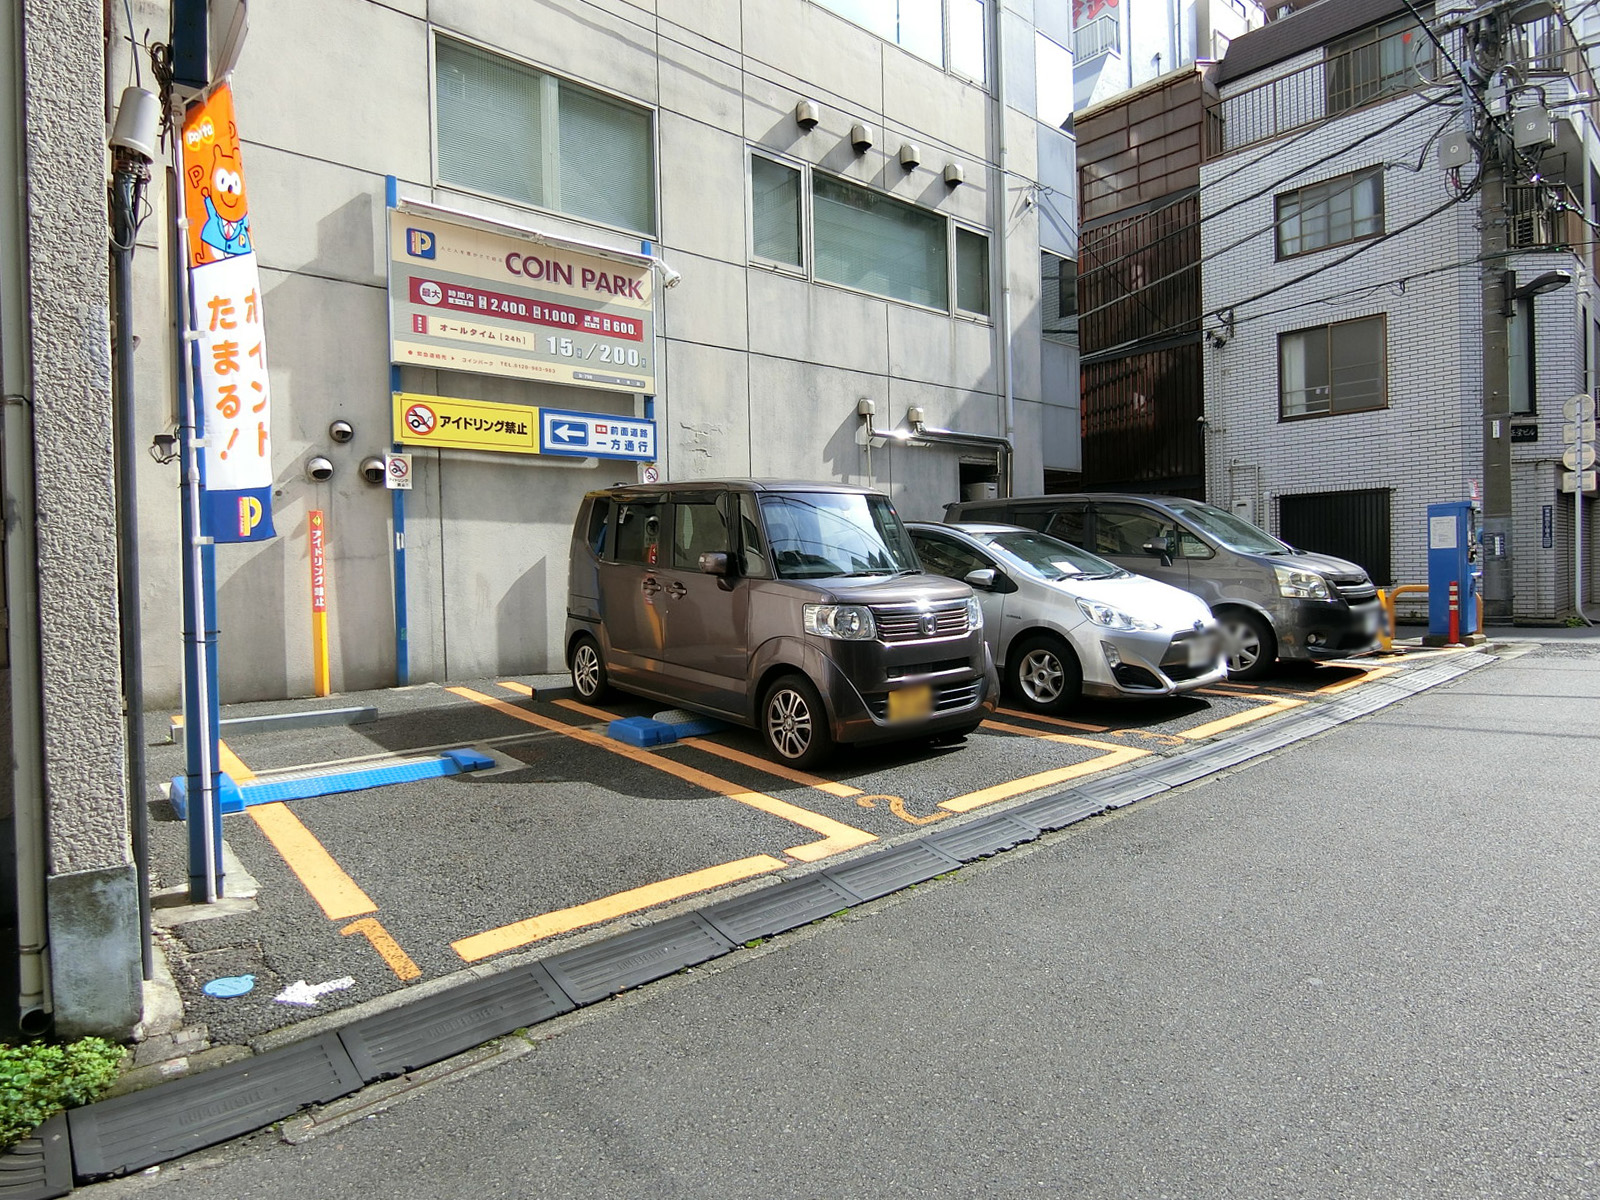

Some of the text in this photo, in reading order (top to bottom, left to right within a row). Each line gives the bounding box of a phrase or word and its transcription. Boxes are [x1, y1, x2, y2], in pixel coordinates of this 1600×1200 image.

[505, 252, 644, 300] COIN PARK
[440, 324, 496, 339] オールタイム
[440, 415, 528, 435] アイドリング禁止
[611, 426, 648, 438] 前面道路
[597, 440, 649, 453] 一方通行
[312, 530, 325, 607] アイドリング禁止
